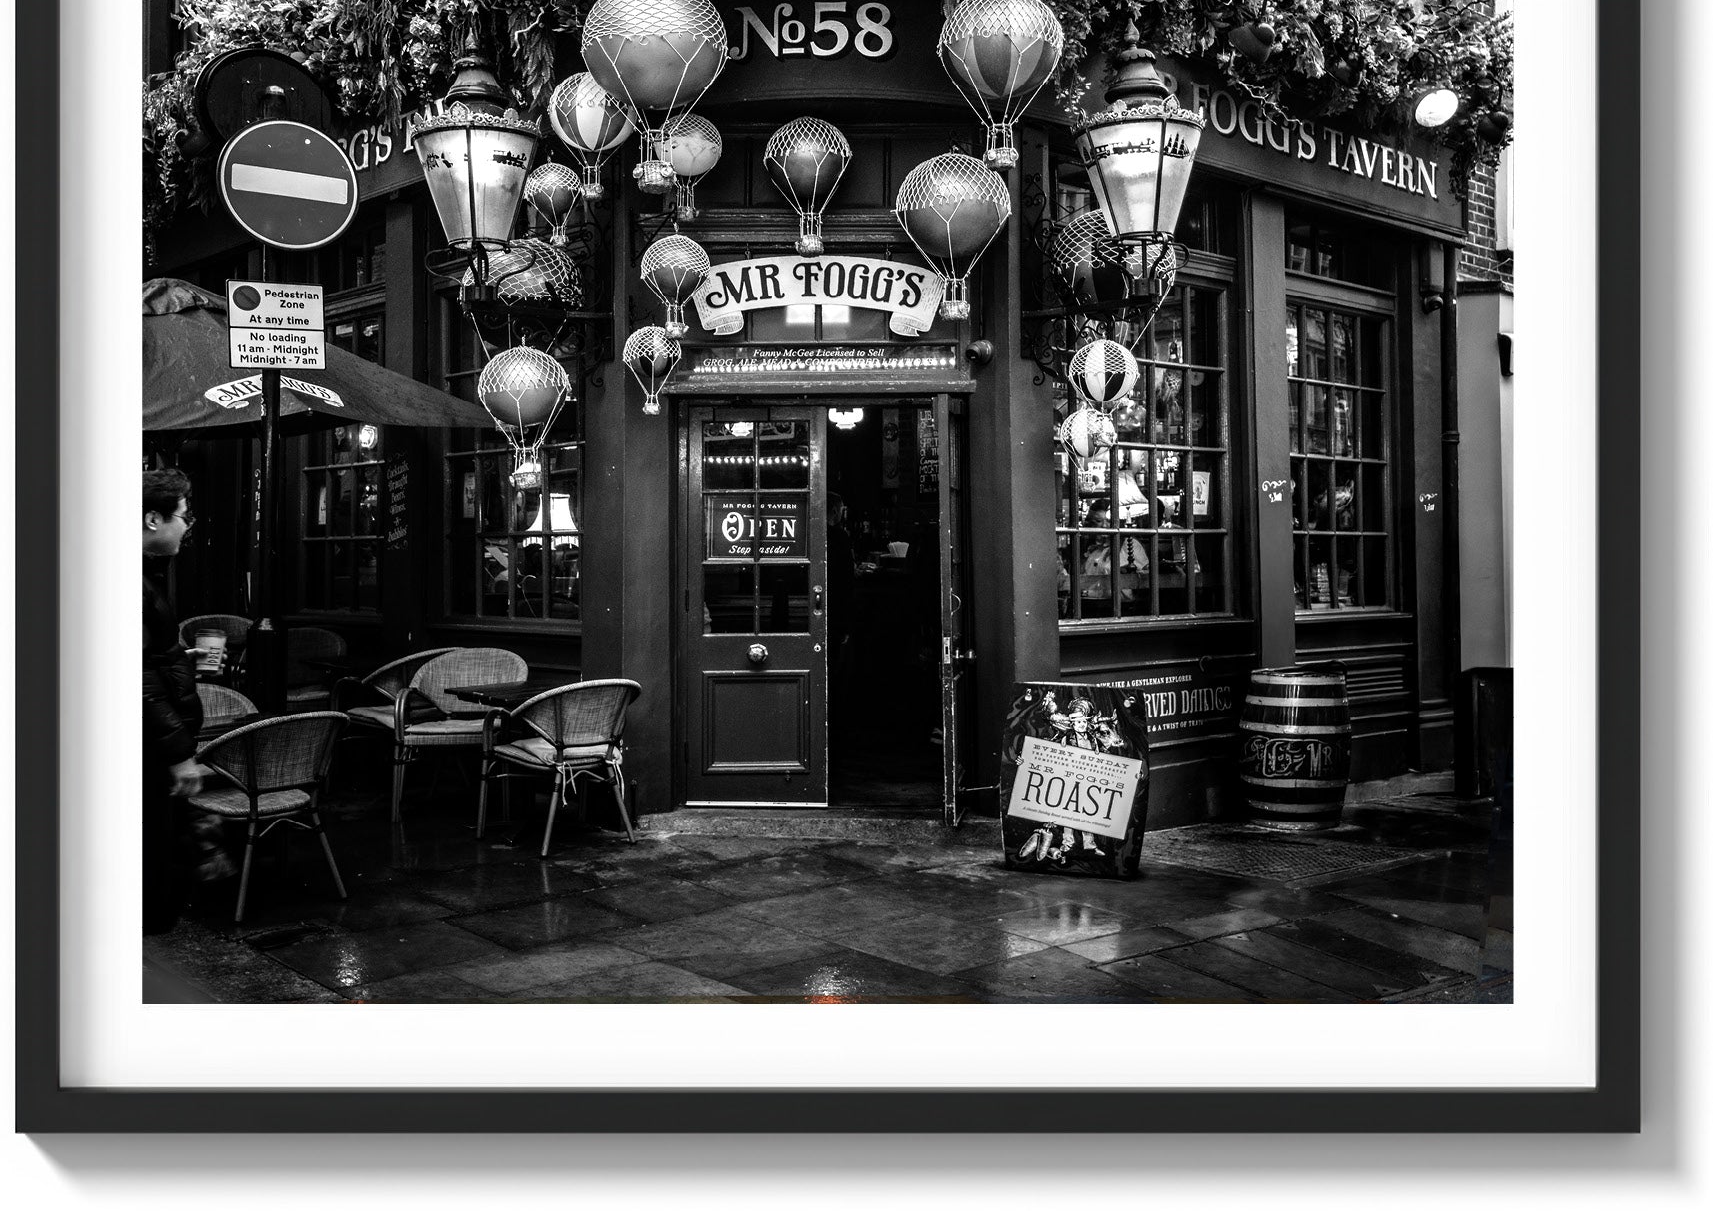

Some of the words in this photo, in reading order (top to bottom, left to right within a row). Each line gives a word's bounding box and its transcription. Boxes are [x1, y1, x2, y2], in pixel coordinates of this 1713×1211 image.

[1323, 128, 1438, 199] TAVERN
[705, 264, 785, 309] MR
[792, 261, 925, 308] FOGG'S
[264, 290, 320, 300] Pedestrian
[279, 300, 305, 309] Zone
[249, 315, 262, 324] At
[265, 317, 284, 326] any
[287, 316, 310, 325] time
[250, 332, 265, 341] No
[268, 333, 306, 344] loading
[273, 345, 319, 356] Midnight
[753, 349, 781, 358] Fanny
[783, 349, 815, 357] McGee
[816, 349, 855, 357] Licensed
[856, 349, 865, 357] to
[867, 349, 884, 357] Sell
[240, 354, 287, 365] Midnight
[218, 380, 263, 403] MR
[729, 545, 751, 554] Step
[759, 546, 789, 554] nside!
[1131, 677, 1165, 686] GENTLEMAN
[1165, 674, 1192, 684] EXPLORER
[1033, 744, 1075, 757] EVERY
[1080, 754, 1130, 769] SUNDAY
[1028, 763, 1054, 774] MR
[1064, 770, 1125, 789] FOGG'S
[1021, 770, 1123, 821] ROAST
